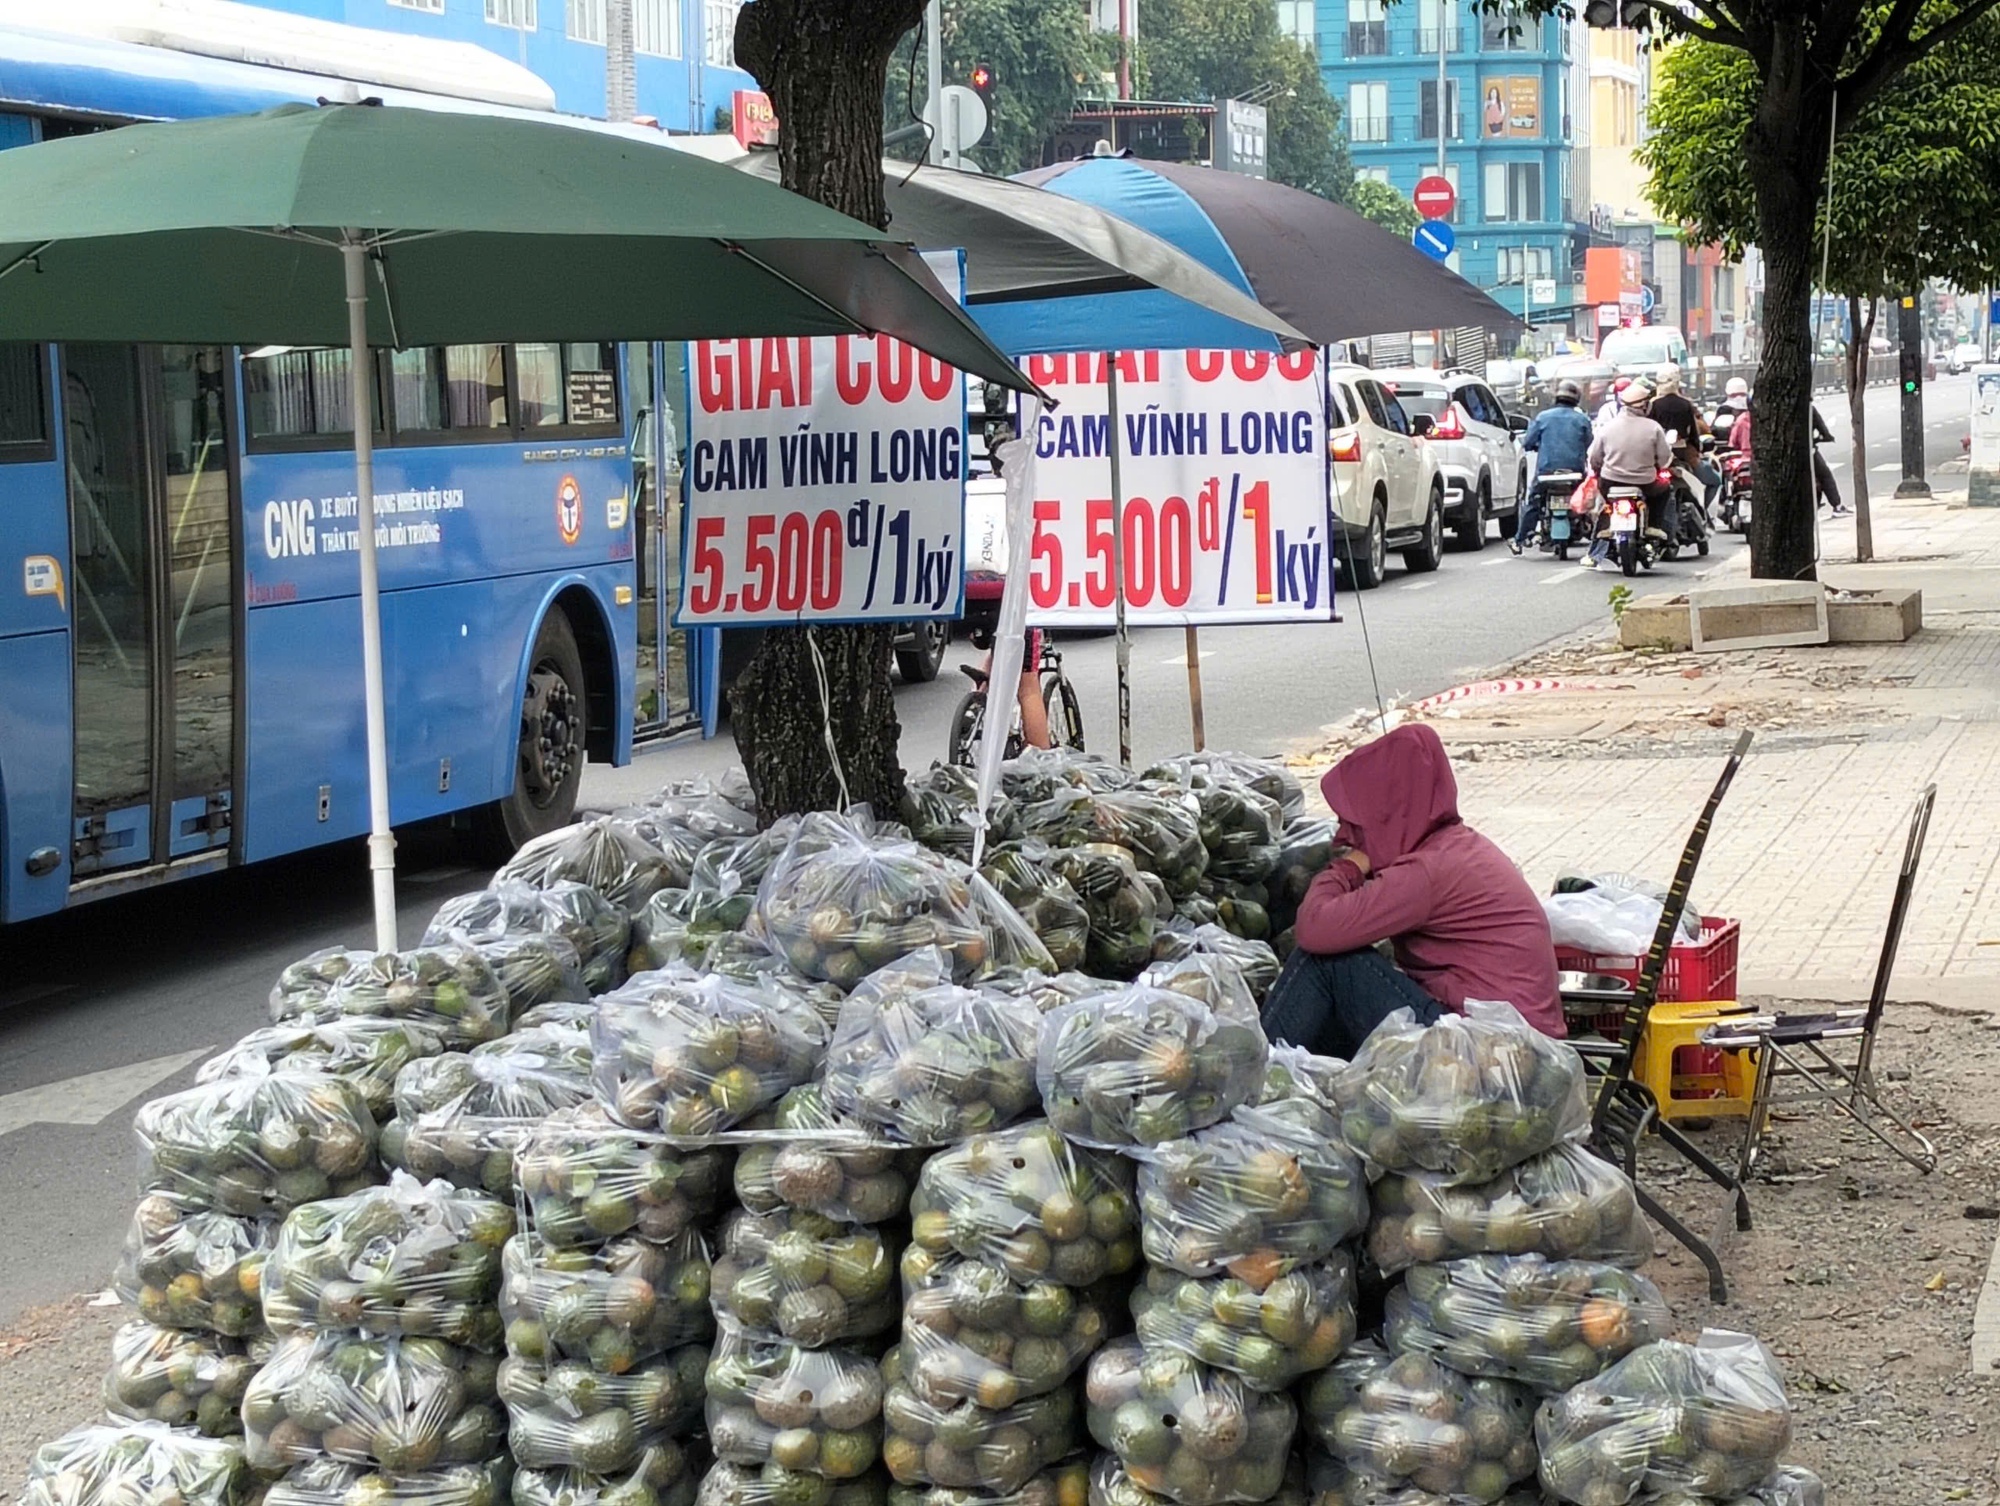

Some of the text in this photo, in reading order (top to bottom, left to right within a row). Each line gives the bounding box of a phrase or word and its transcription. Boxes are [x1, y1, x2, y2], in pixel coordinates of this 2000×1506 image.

[693, 421, 960, 493] CAM VĨNH LONG
[1034, 403, 1313, 459] CAM VĨNH LONG
[264, 498, 317, 560] CNG
[320, 497, 335, 519] XE
